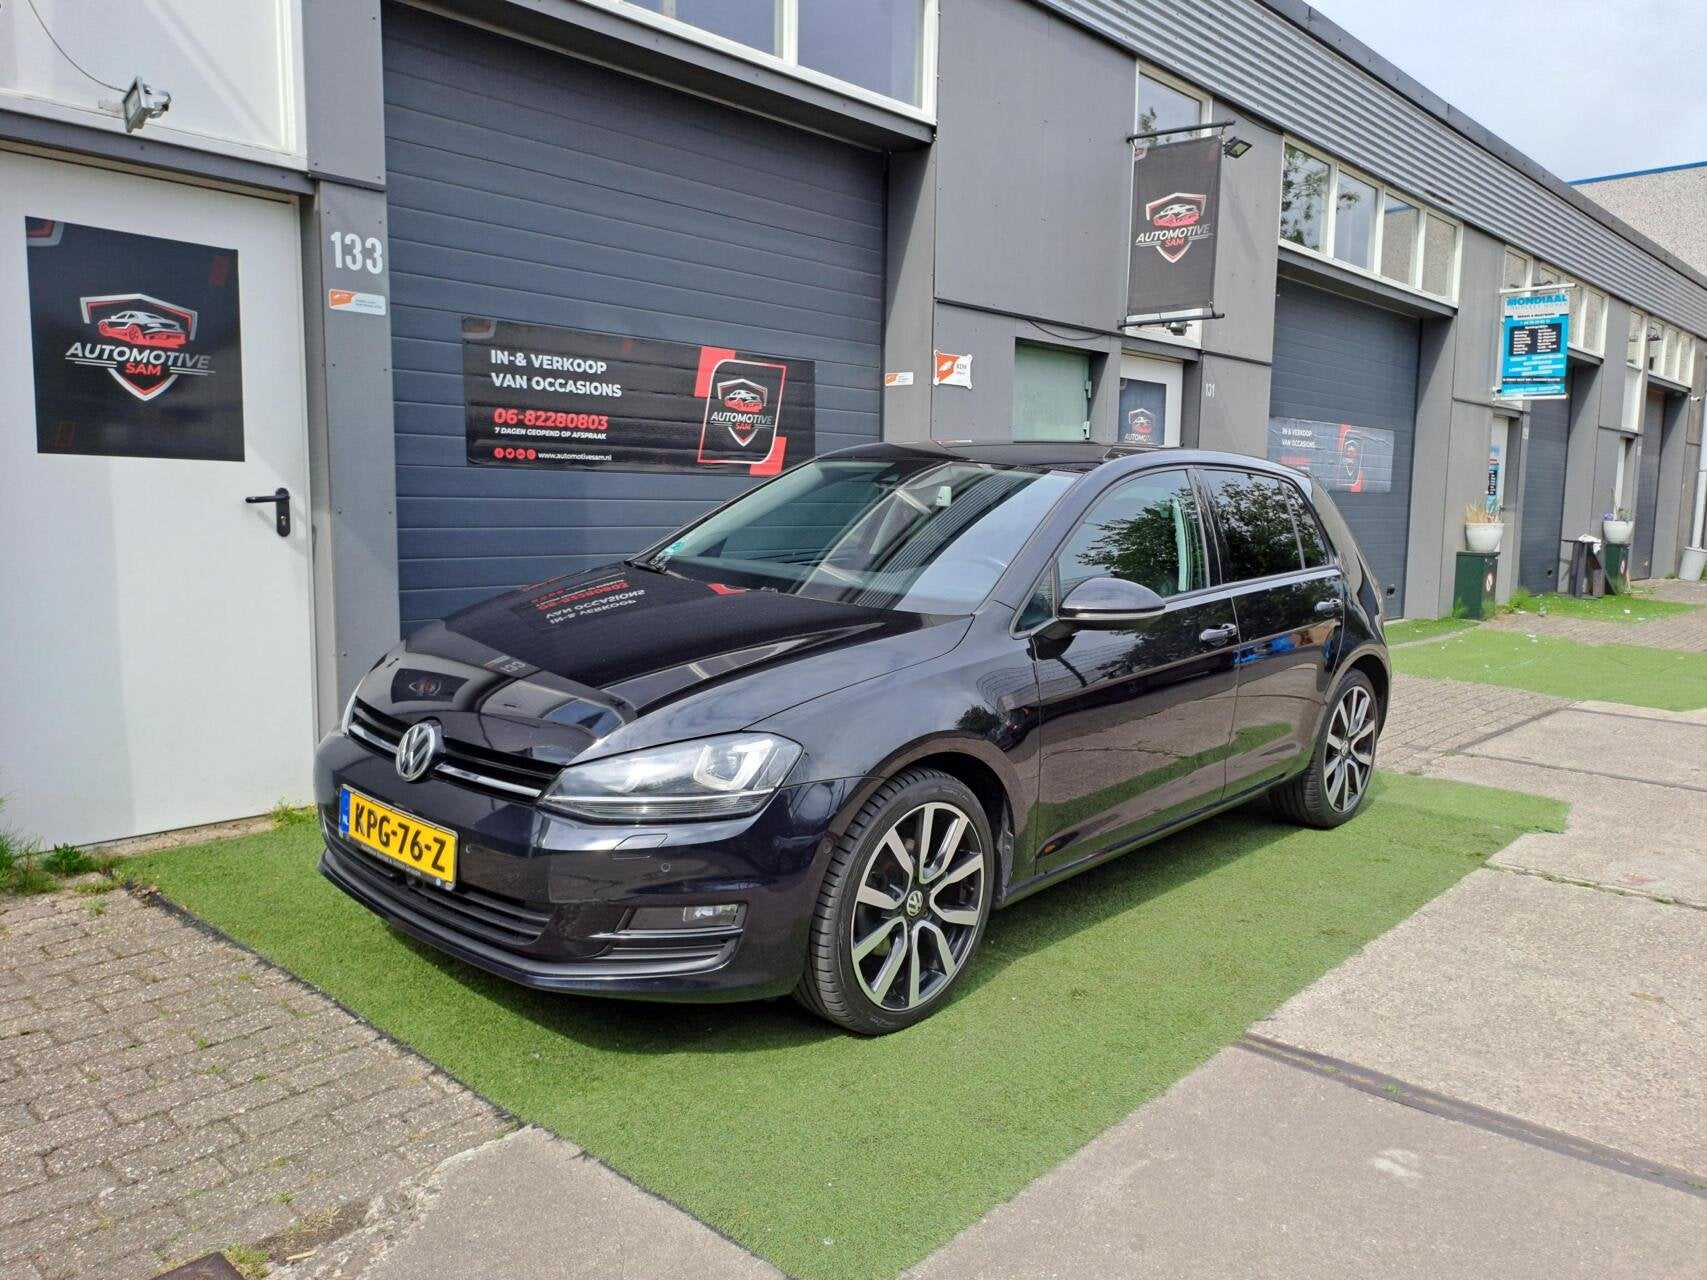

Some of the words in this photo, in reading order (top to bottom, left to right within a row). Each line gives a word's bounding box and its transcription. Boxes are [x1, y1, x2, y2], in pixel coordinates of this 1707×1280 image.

[1135, 223, 1211, 243] AUTOMOTIVE
[1164, 238, 1185, 247] SAM
[330, 231, 383, 274] 133
[1507, 294, 1568, 306] MONDIAAL
[65, 342, 211, 369] AUTOMOTIVE
[125, 362, 162, 376] SAM
[530, 354, 607, 374] VERKOOP
[490, 372, 528, 389] VAN
[531, 376, 622, 397] OCCASIONS
[1205, 383, 1215, 398] 131
[494, 407, 609, 430] 06-82280803
[710, 411, 773, 424] AUTOMOTIVE
[500, 427, 526, 435] DAGEN
[526, 429, 560, 437] GEOPEND
[571, 432, 607, 440] AFSPRAAK
[735, 422, 752, 430] SAM
[538, 452, 612, 461] www.automotivesam.nl
[355, 802, 447, 873] KPG-76-Z
